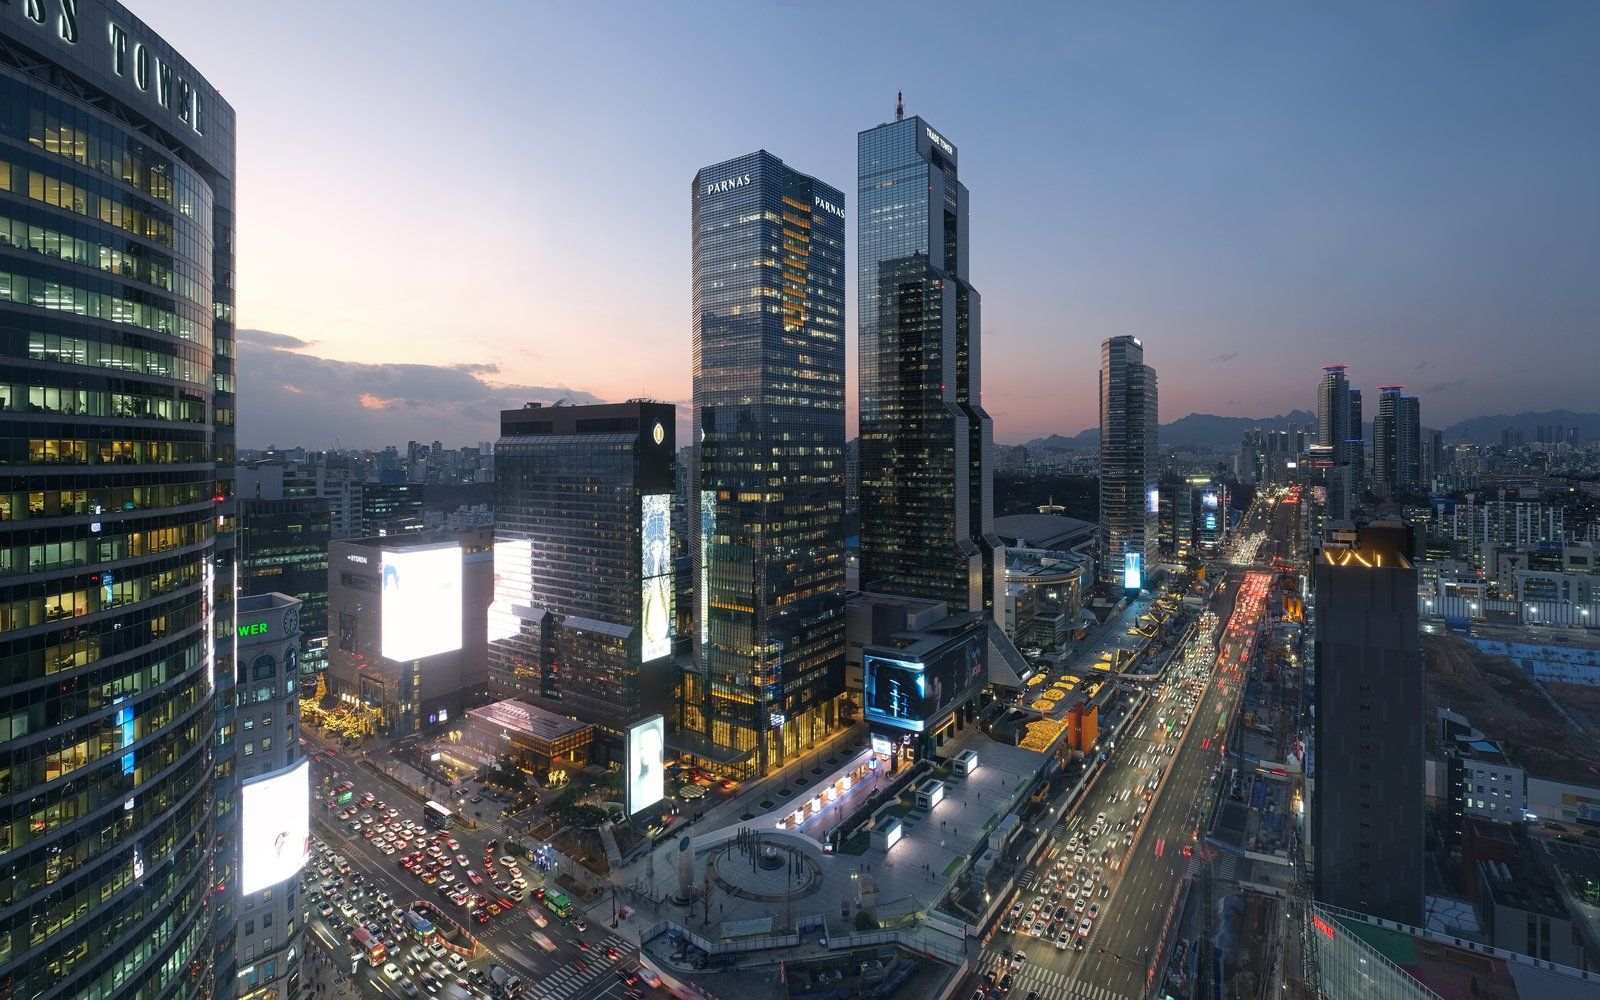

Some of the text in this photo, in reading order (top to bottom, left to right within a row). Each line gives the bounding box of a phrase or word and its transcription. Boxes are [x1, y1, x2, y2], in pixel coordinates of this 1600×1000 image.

[109, 22, 206, 137] TOWER
[707, 173, 751, 195] PARNAS
[815, 196, 845, 219] PARNAS
[238, 622, 268, 637] WER
